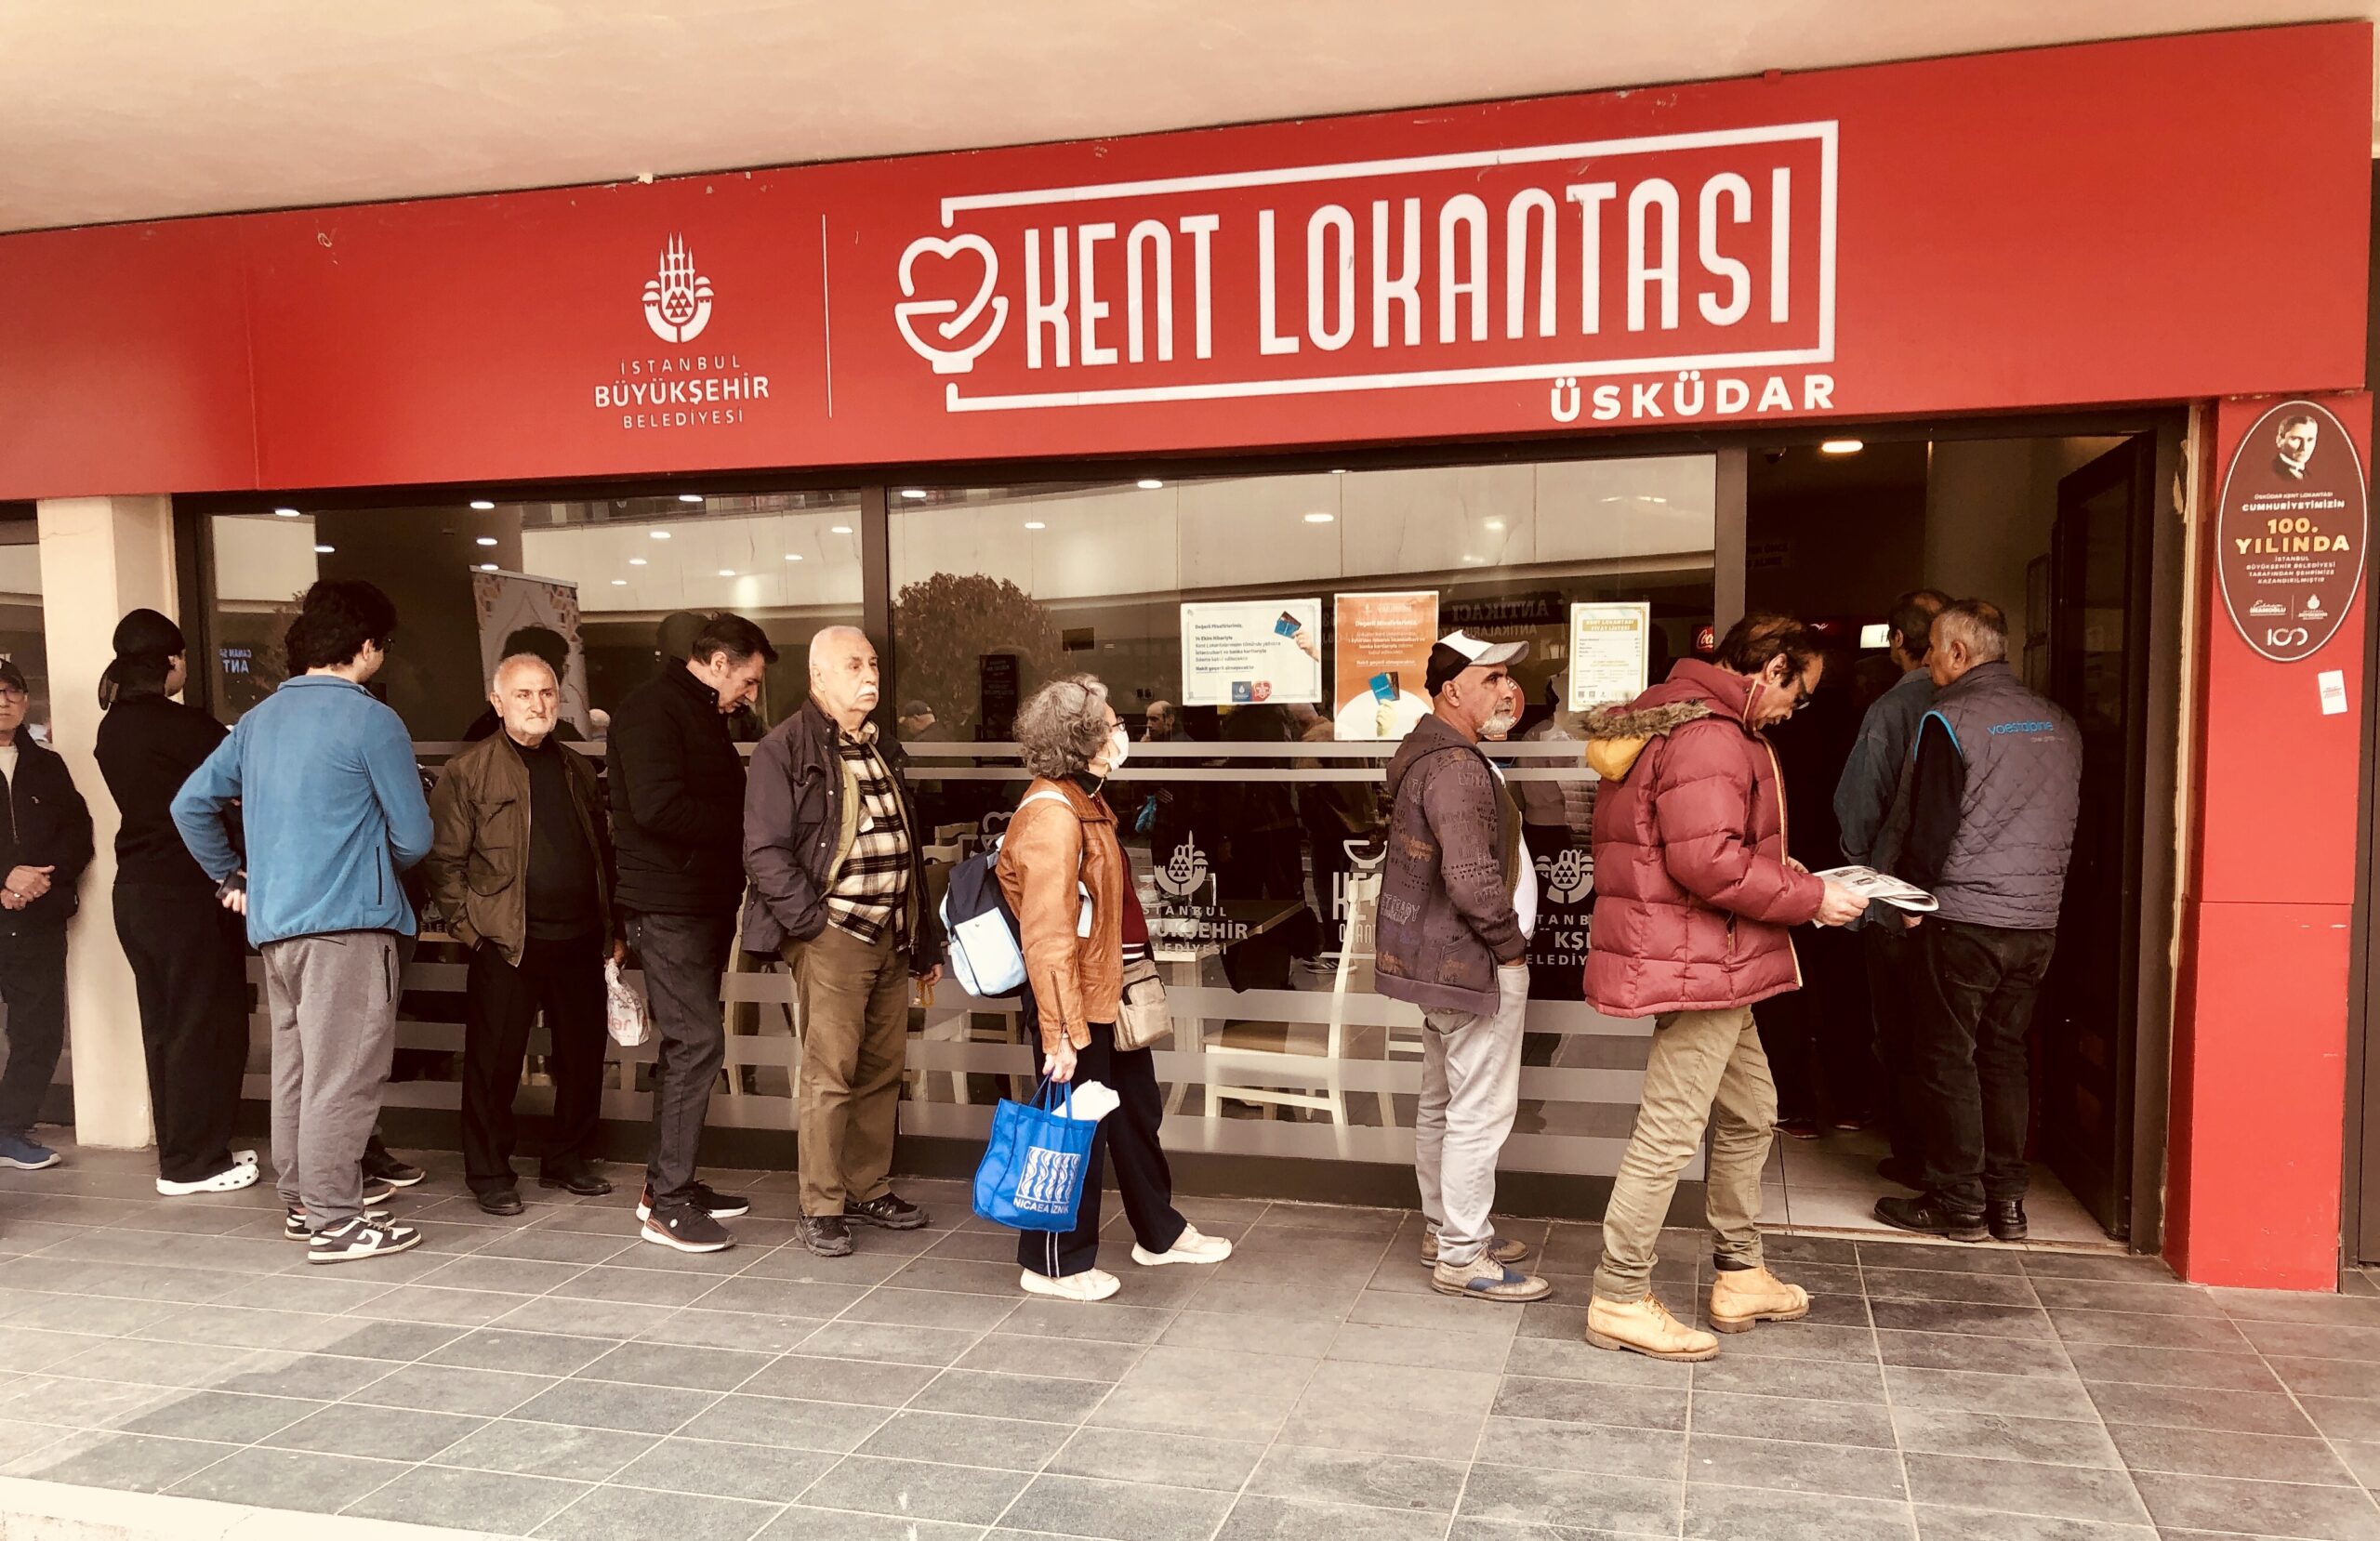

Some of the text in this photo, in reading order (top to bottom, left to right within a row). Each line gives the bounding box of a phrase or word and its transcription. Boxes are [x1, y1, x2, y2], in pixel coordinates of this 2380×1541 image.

[1024, 166, 1792, 369] KENT LOKANTASI
[594, 372, 770, 408] BÜYÜKŞEHİR
[1549, 371, 1835, 423] ÜSKÜDAR
[623, 409, 743, 428] BELEDİYESİ
[2242, 499, 2346, 511] CUMHURİYETİMİZİN
[2268, 517, 2319, 534] 100.
[2235, 534, 2350, 555] YILINDA
[1143, 905, 1227, 917] STANBUL
[1012, 1196, 1050, 1214] NICAEA
